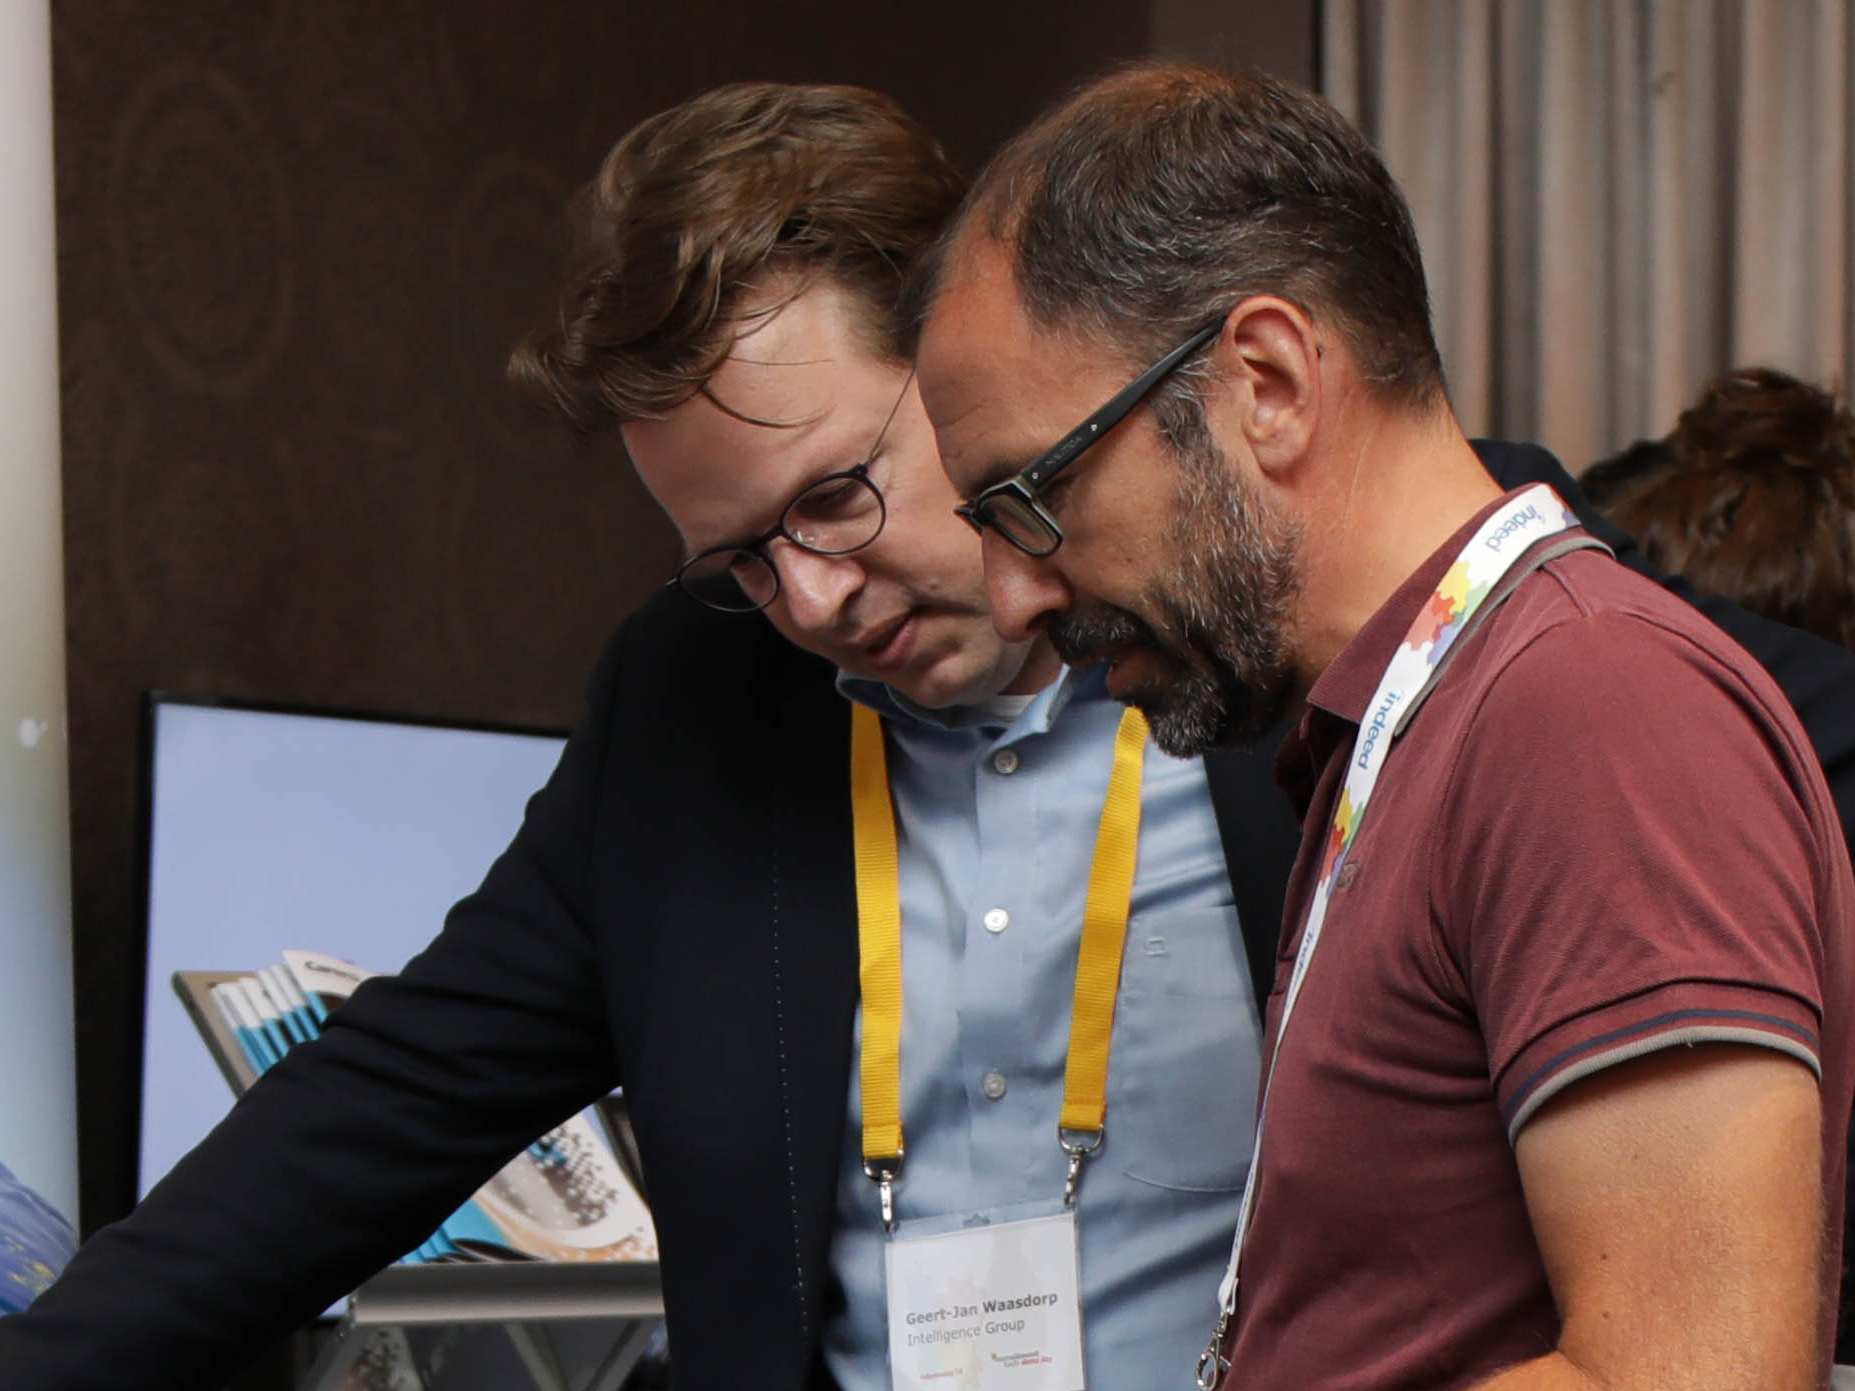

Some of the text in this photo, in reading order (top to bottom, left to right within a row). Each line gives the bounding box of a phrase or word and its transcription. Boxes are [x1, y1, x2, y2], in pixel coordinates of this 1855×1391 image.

[1484, 503, 1546, 553] indeed
[1357, 690, 1403, 770] indeed
[906, 1292, 1059, 1325] Geert-Jan Waasdorp
[907, 1318, 1026, 1347] Intelligence Group
